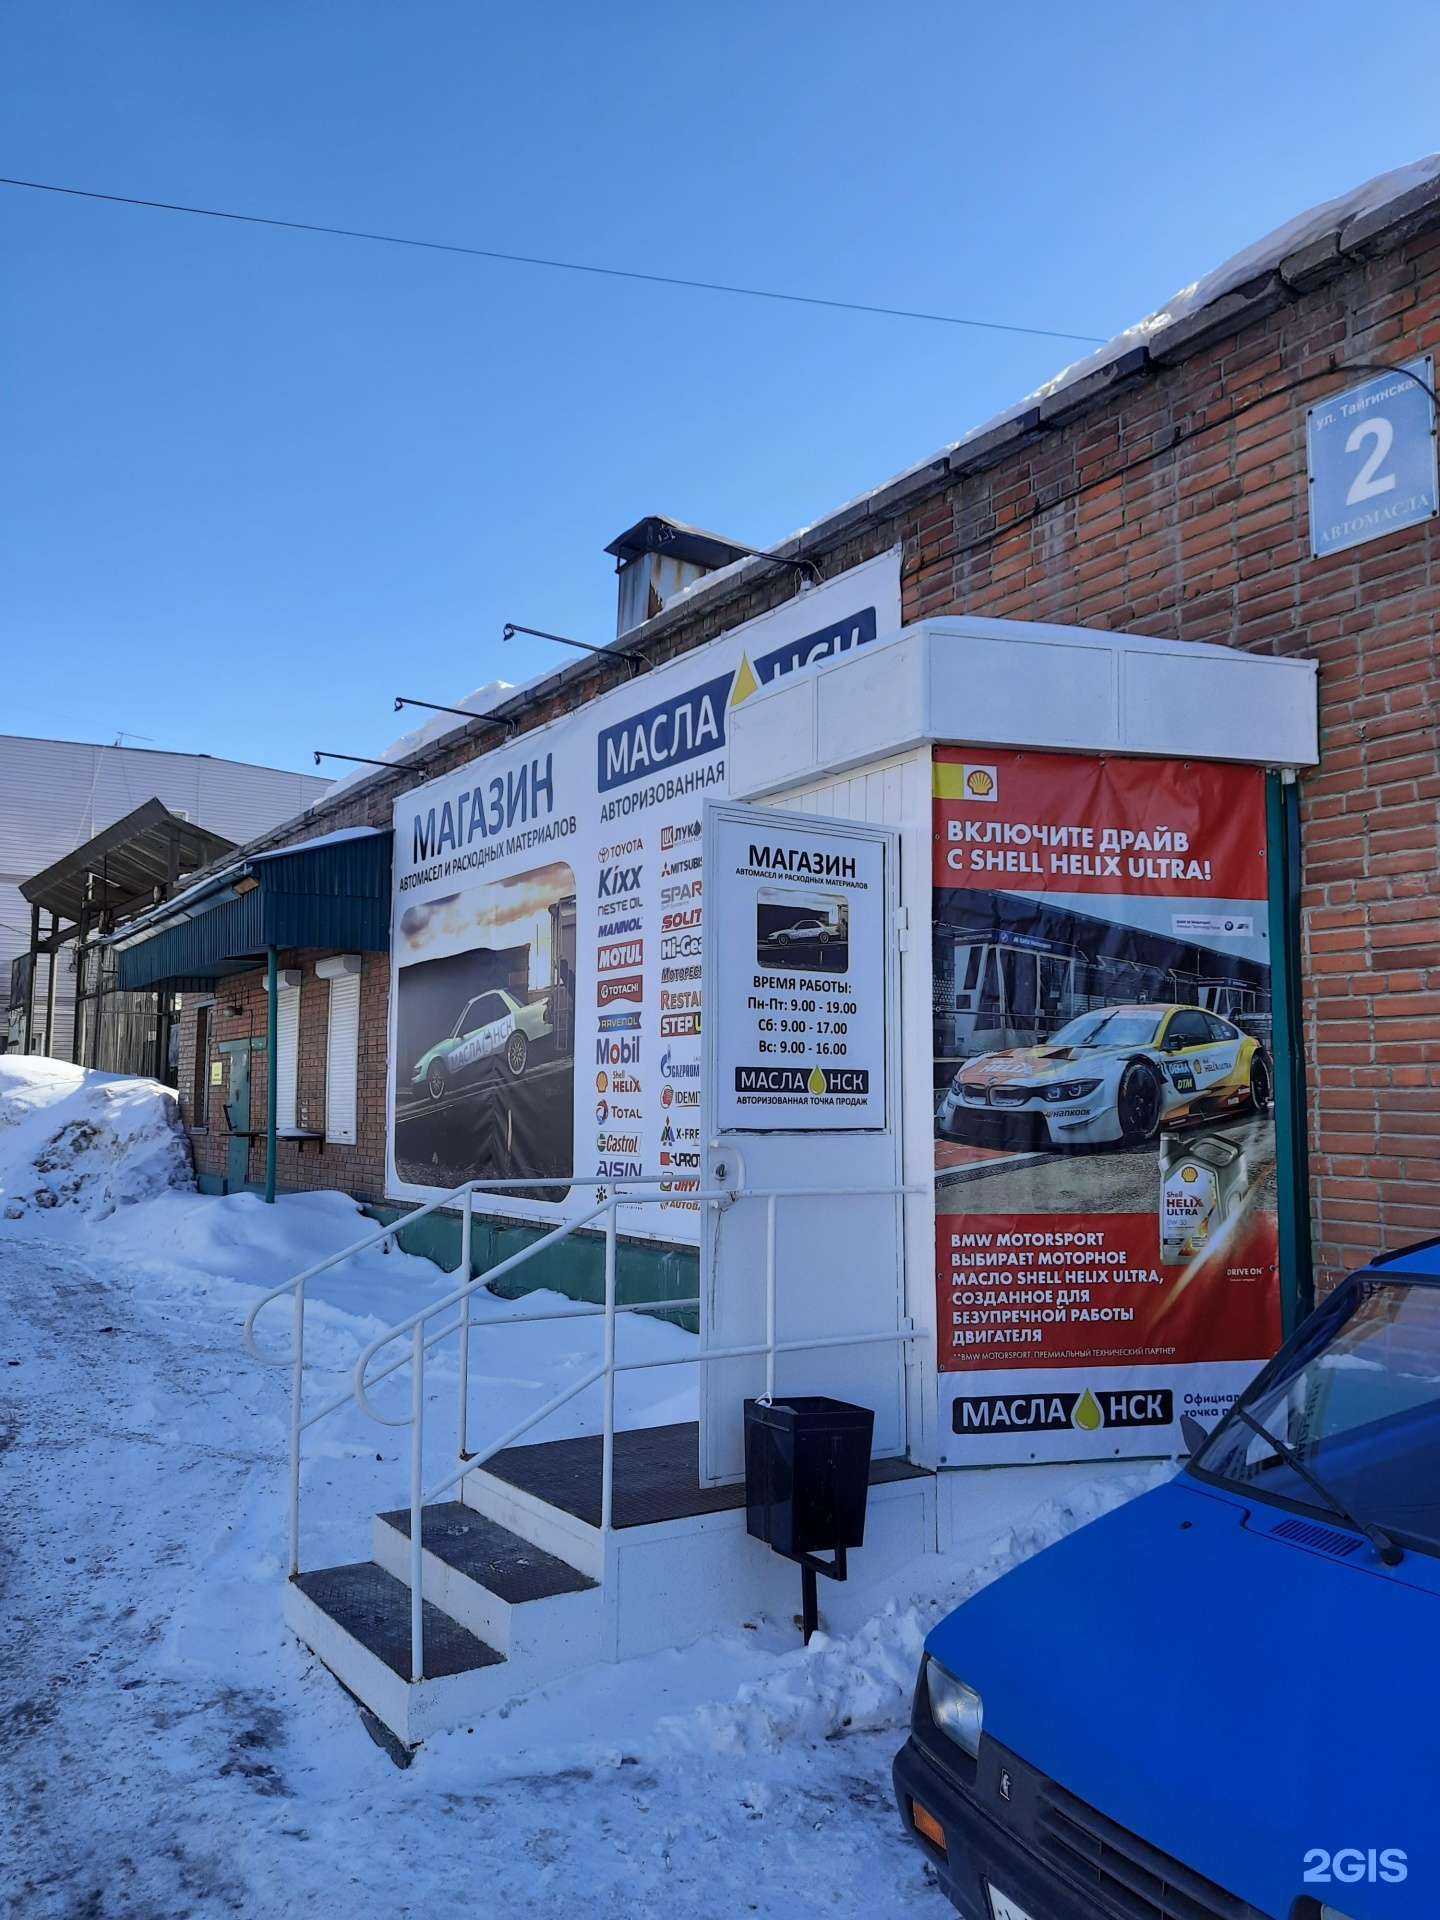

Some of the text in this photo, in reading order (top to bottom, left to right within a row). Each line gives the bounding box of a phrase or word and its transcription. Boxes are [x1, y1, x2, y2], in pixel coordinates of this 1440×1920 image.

[1316, 413, 1337, 432] ул.
[1344, 417, 1396, 506] 2
[1320, 493, 1429, 545] АВТОМАСЛА
[605, 694, 719, 781] МАСЛА
[600, 760, 725, 823] АВТОРИЗОВАННАЯ
[413, 752, 554, 865] МАГАЗИН
[946, 819, 1190, 854] ВКЛЮЧИТЕ ДРАЙВ
[399, 815, 577, 893] АВТОМАСЕЛ И РАСХОДНЫХ МАТЕРИАЛОВ
[610, 837, 644, 858] TOYOTA
[749, 844, 856, 878] МАГАЗИН
[946, 848, 1213, 881] С SHELL HELIX ULTRA!
[735, 867, 777, 879] АВТОМАСЕЛ
[784, 873, 824, 885] РАСХОДНЫХ
[825, 878, 868, 890] МАТЕРИАЛОВ
[629, 896, 644, 911] OIL
[598, 917, 642, 938] MANNOL
[599, 943, 642, 970] MOTUL
[608, 983, 639, 996] TOTACHI
[753, 975, 852, 994] ВРЕМЯ РАБОТЫ:
[747, 997, 788, 1011] Пн-Пт:
[790, 999, 816, 1012] 9.00
[826, 1001, 857, 1014] 19.00
[601, 1016, 638, 1029] RAVENOL
[662, 1015, 694, 1034] STEP
[758, 1018, 777, 1031] Сб:
[780, 1019, 806, 1033] 9.00
[816, 1021, 848, 1035] 17.00
[450, 1036, 482, 1068] МАСЛА
[596, 1035, 640, 1065] Mobil
[758, 1040, 777, 1053] Вс:
[779, 1040, 805, 1054] 9.00
[816, 1043, 847, 1056] 16.00
[612, 1070, 625, 1080] Shell
[741, 1071, 864, 1091] МАСЛА НСК
[612, 1080, 642, 1093] HELIX
[736, 1095, 868, 1106] АВТОРИЗОВАННАЯ ТОЧКА ПРОДАЖ
[606, 1134, 638, 1153] Castrol
[596, 1160, 642, 1177] AISIN
[1166, 1198, 1204, 1208] HELIX
[1166, 1208, 1199, 1216] ULTRA
[951, 1232, 1104, 1248] BMW MOTORSPORT
[951, 1251, 1127, 1267] ВЫБИРАЕТ МОТОРНОЕ
[951, 1268, 1164, 1286] МАСЛО SHELL HELIX ULTRA,
[1226, 1268, 1249, 1276] DRIVE
[952, 1290, 1091, 1306] СОЗДАННОЕ ДЛЯ
[952, 1306, 1134, 1326] БЕЗУПРЕЧНОЙ РАБОТЫ
[952, 1329, 1043, 1347] ДВИГАТЕЛЯ
[1034, 1349, 1092, 1359] ПРЕМИАЛЬНЫЙ
[1092, 1347, 1144, 1358] ТЕХНИЧЕСКИЙ
[1144, 1347, 1176, 1356] ПАРТНЕР
[962, 1394, 1164, 1427] МАСЛА НСК
[1184, 1408, 1219, 1417] точка
